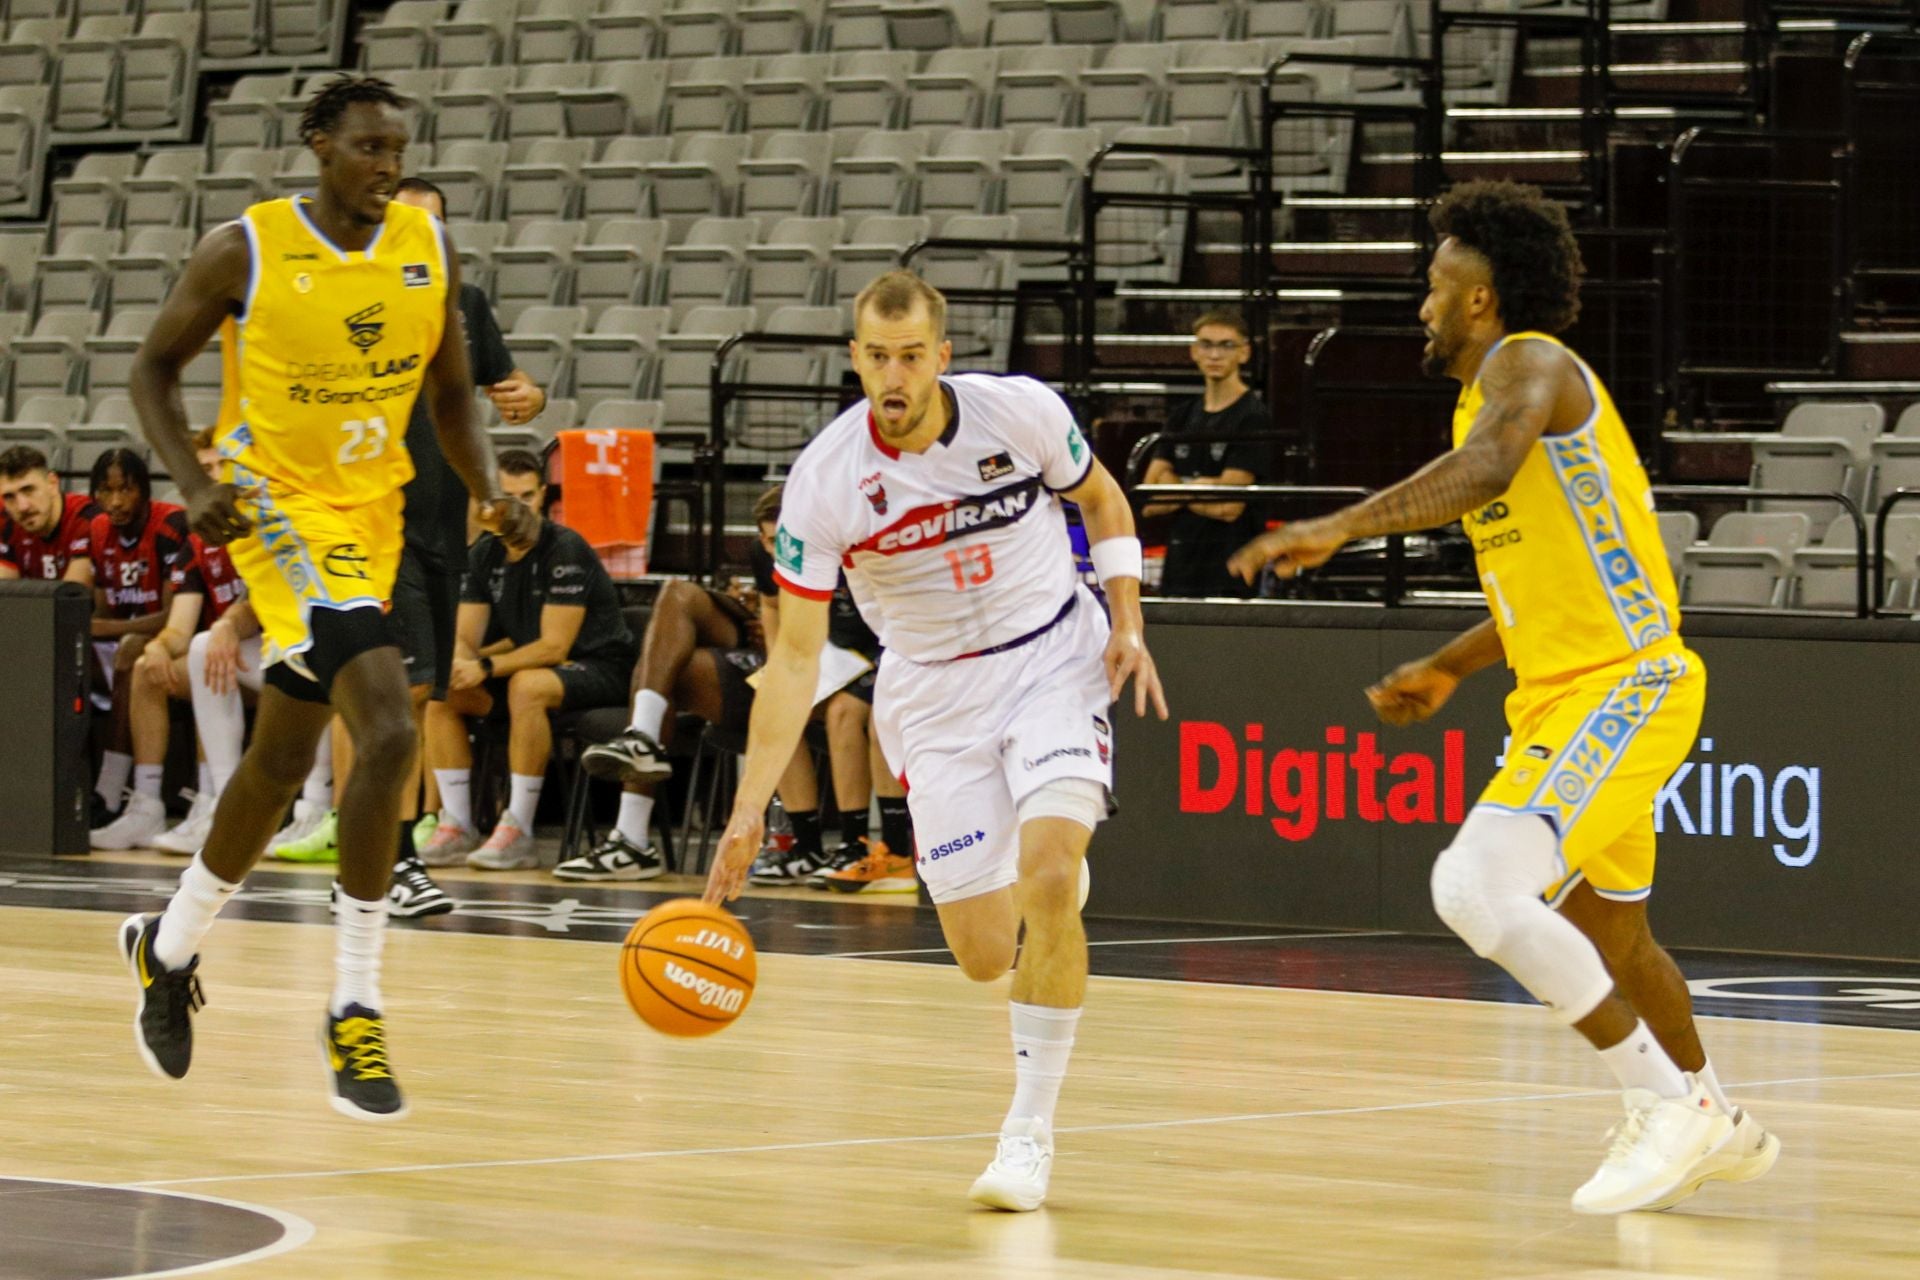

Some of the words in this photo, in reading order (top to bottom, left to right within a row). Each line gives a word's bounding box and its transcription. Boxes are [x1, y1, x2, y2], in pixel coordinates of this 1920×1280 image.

[338, 415, 389, 465] 23
[876, 491, 1028, 550] COVIRAN
[943, 542, 995, 592] 13
[1179, 720, 1465, 841] Digital
[664, 961, 744, 1014] Wilson
